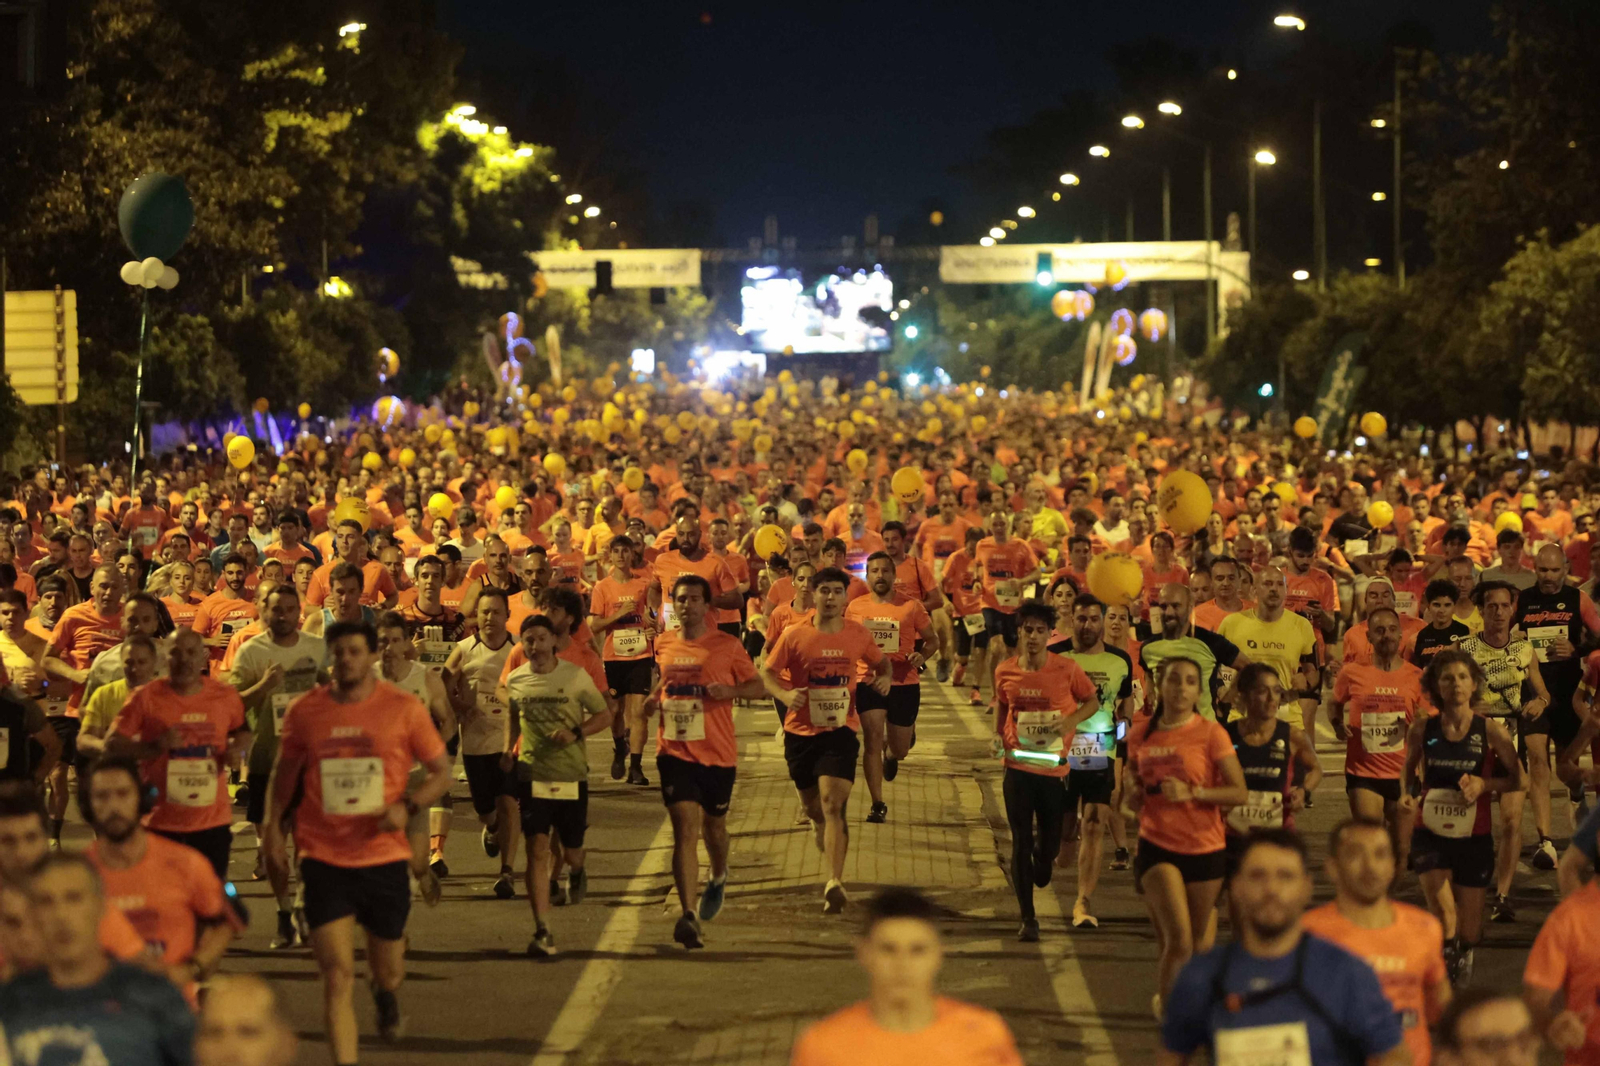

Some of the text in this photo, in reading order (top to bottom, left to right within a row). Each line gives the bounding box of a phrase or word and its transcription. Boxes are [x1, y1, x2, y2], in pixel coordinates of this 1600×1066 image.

[619, 637, 640, 645] 20957
[822, 649, 844, 657] XXXV
[1019, 688, 1042, 696] XXXV
[1374, 685, 1399, 694] XXXV
[1071, 747, 1099, 756] 13174
[1433, 804, 1467, 818] 11956
